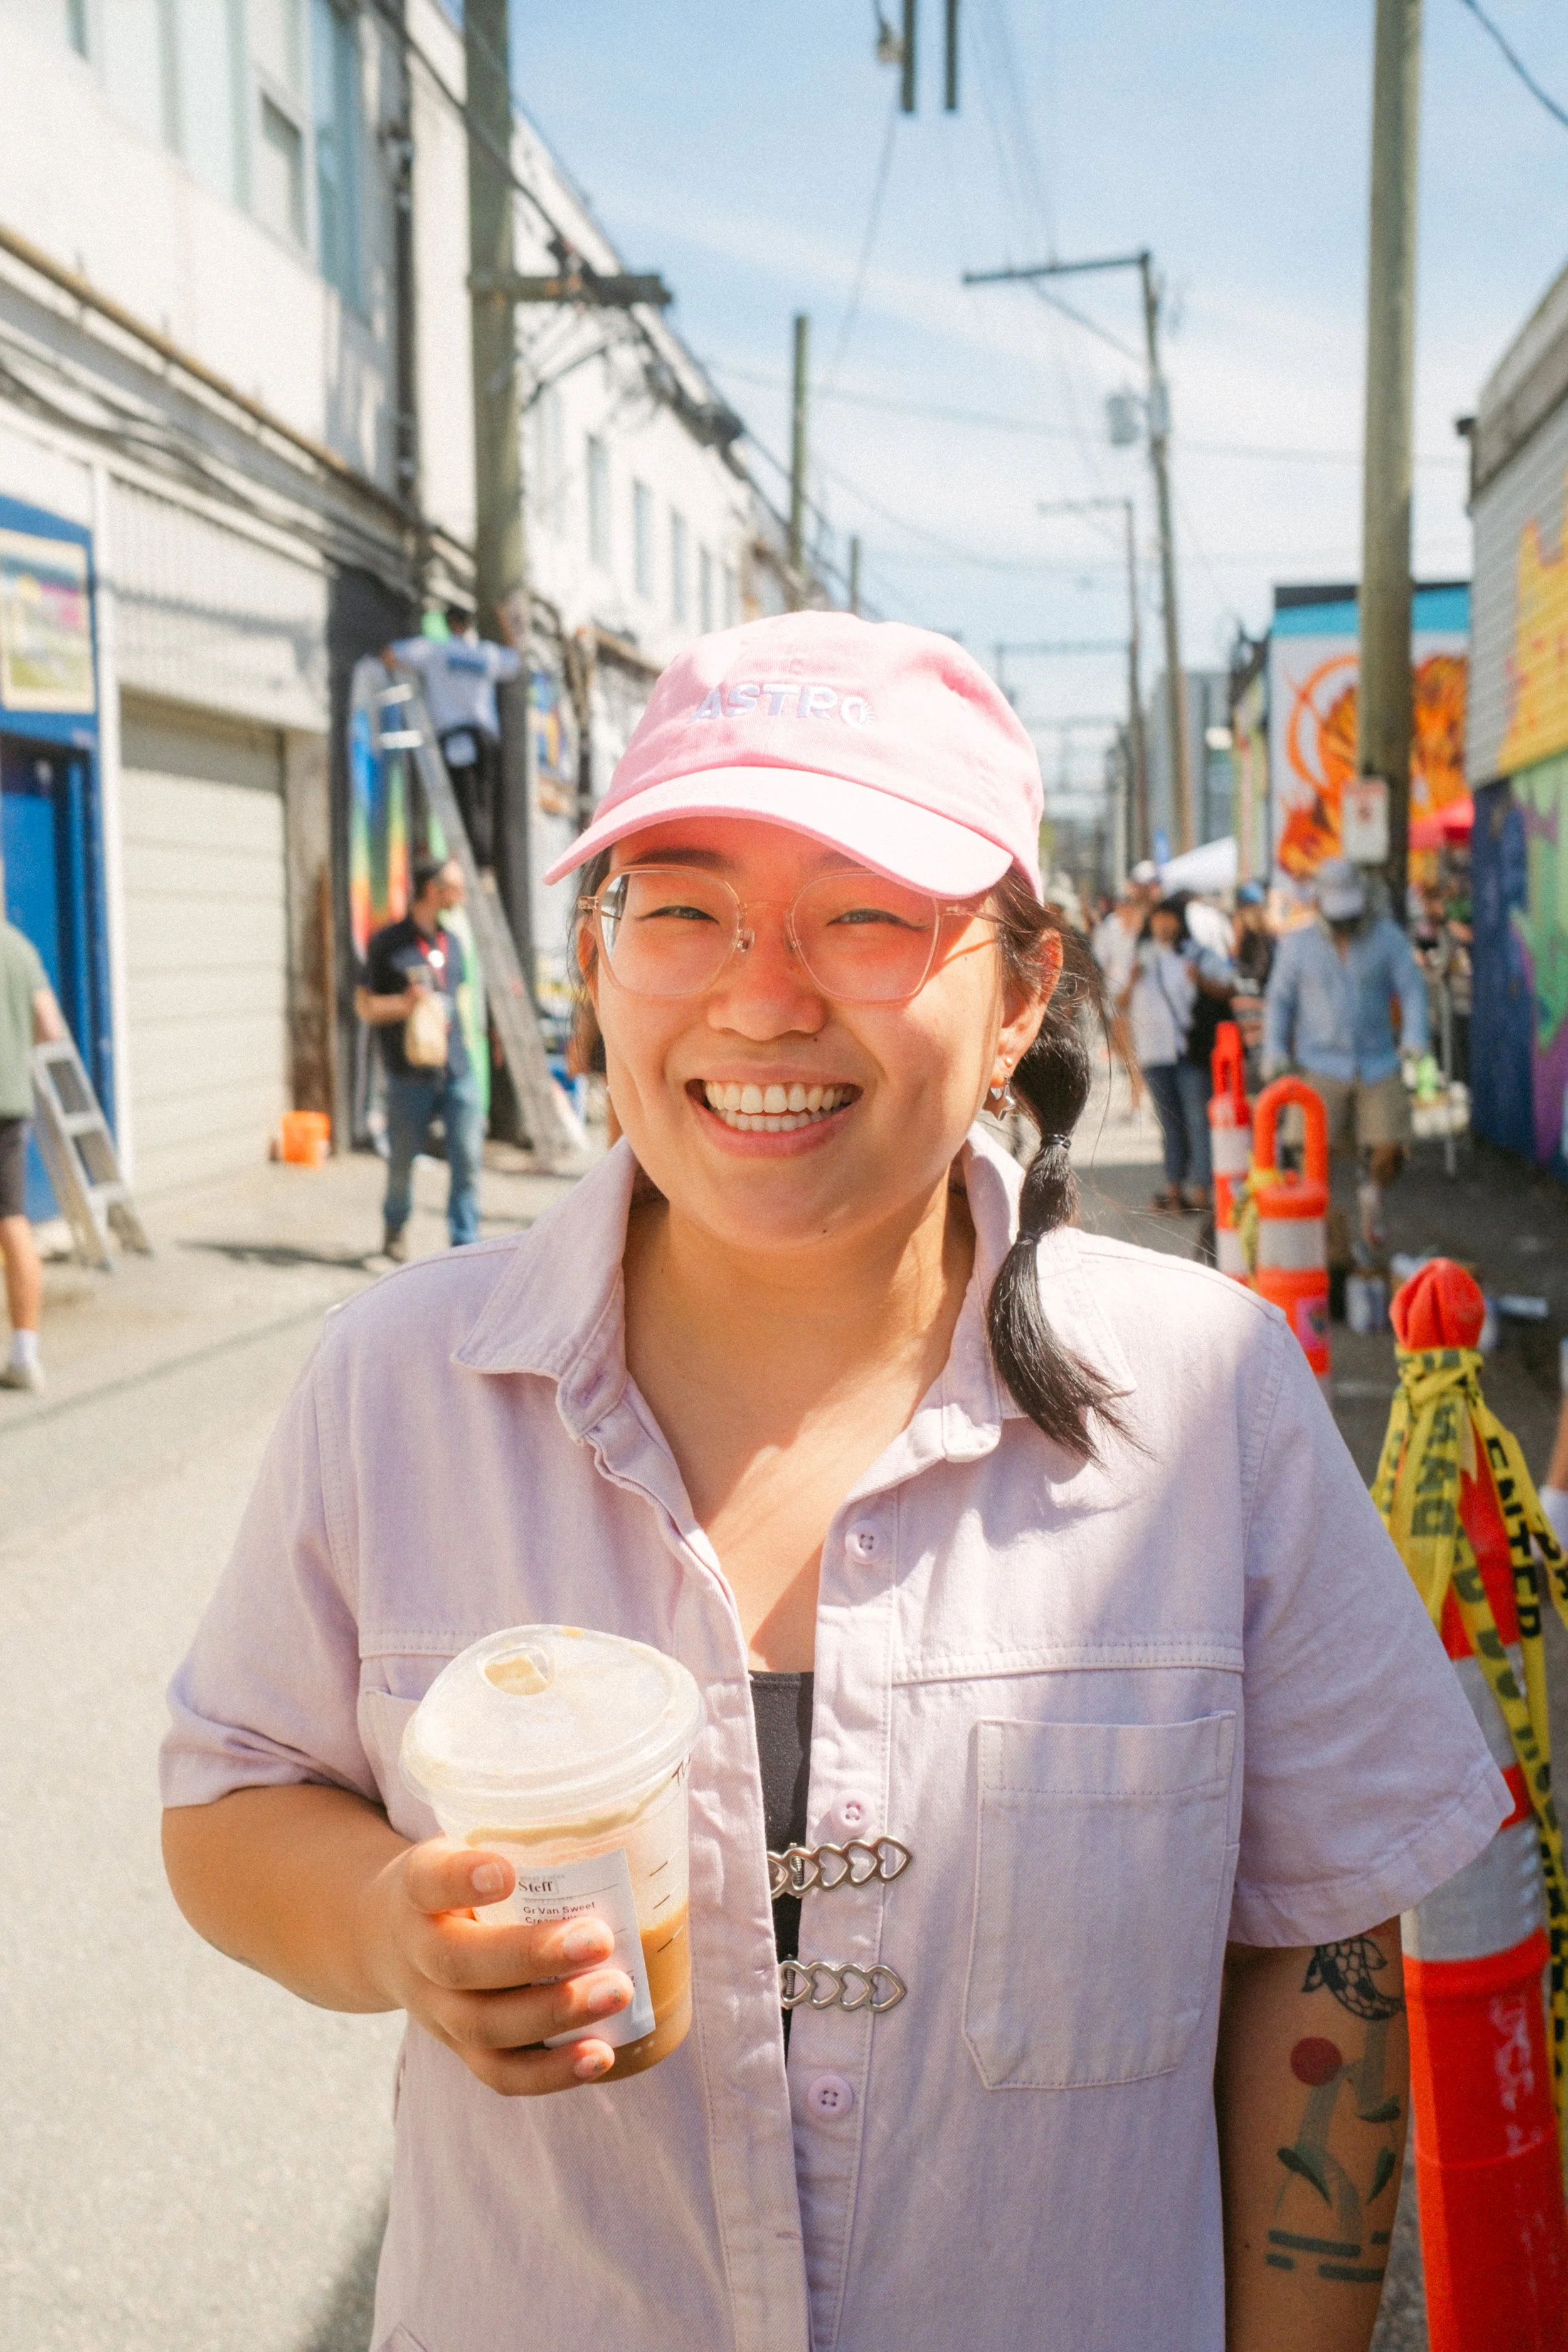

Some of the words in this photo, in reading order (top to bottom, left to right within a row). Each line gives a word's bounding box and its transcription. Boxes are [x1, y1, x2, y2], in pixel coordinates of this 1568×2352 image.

[688, 684, 876, 728] ASTRO
[518, 1881, 553, 1892] Steff
[523, 1906, 535, 1914] Gr
[563, 1902, 596, 1914] Sweet
